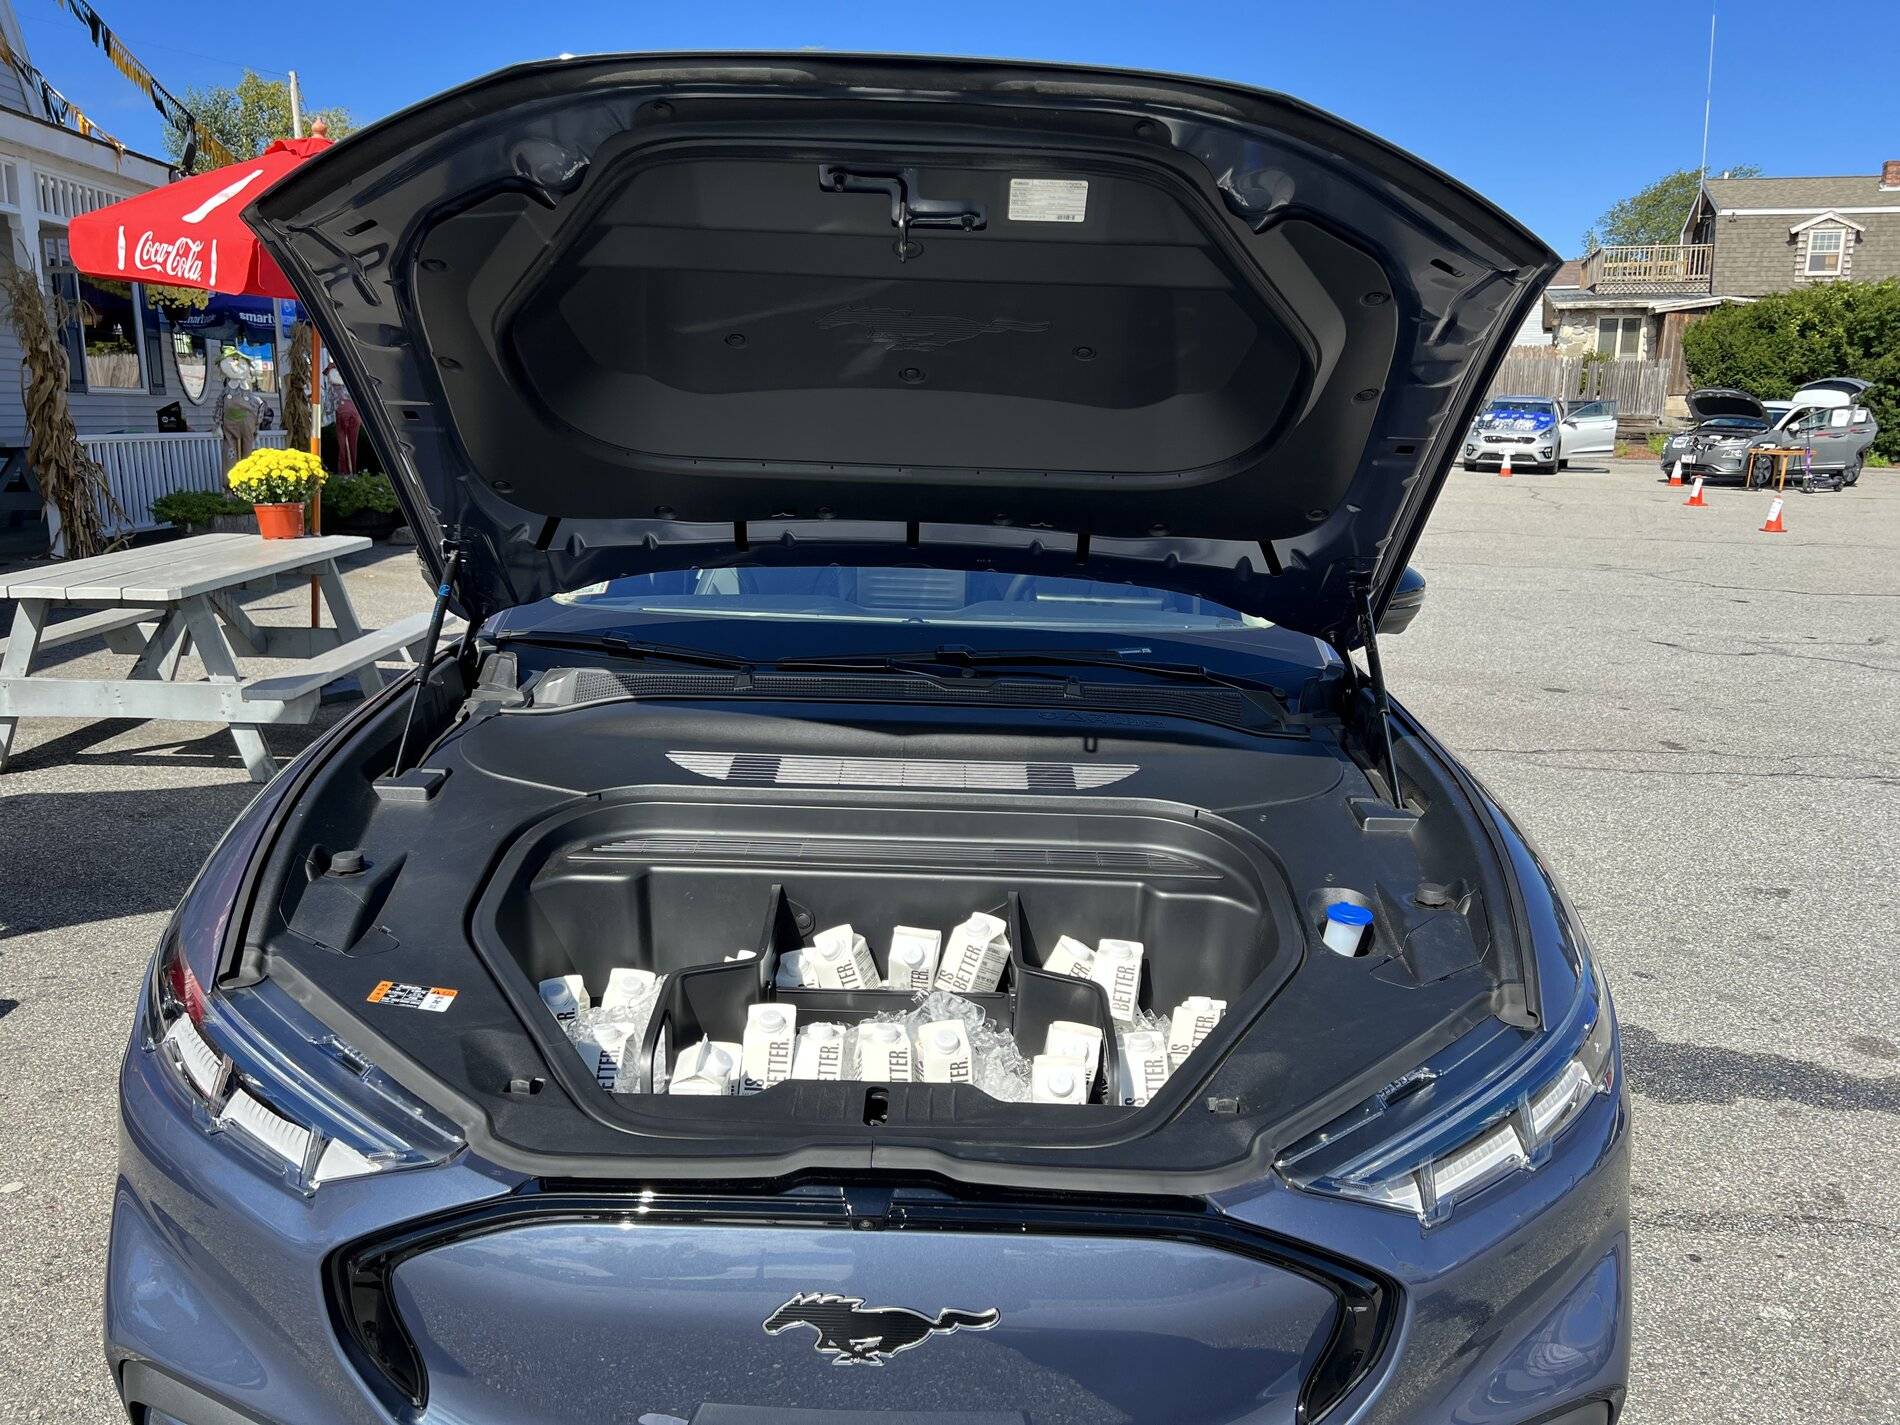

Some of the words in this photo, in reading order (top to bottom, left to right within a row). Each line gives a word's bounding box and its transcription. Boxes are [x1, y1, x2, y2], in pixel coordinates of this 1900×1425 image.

[134, 230, 205, 282] Coca-Cola
[953, 944, 984, 991] BETTER.
[596, 1046, 622, 1092] ETTER.
[766, 1038, 790, 1089] ETTER.
[816, 1043, 840, 1081] TTER.
[889, 1047, 909, 1083] TTER.
